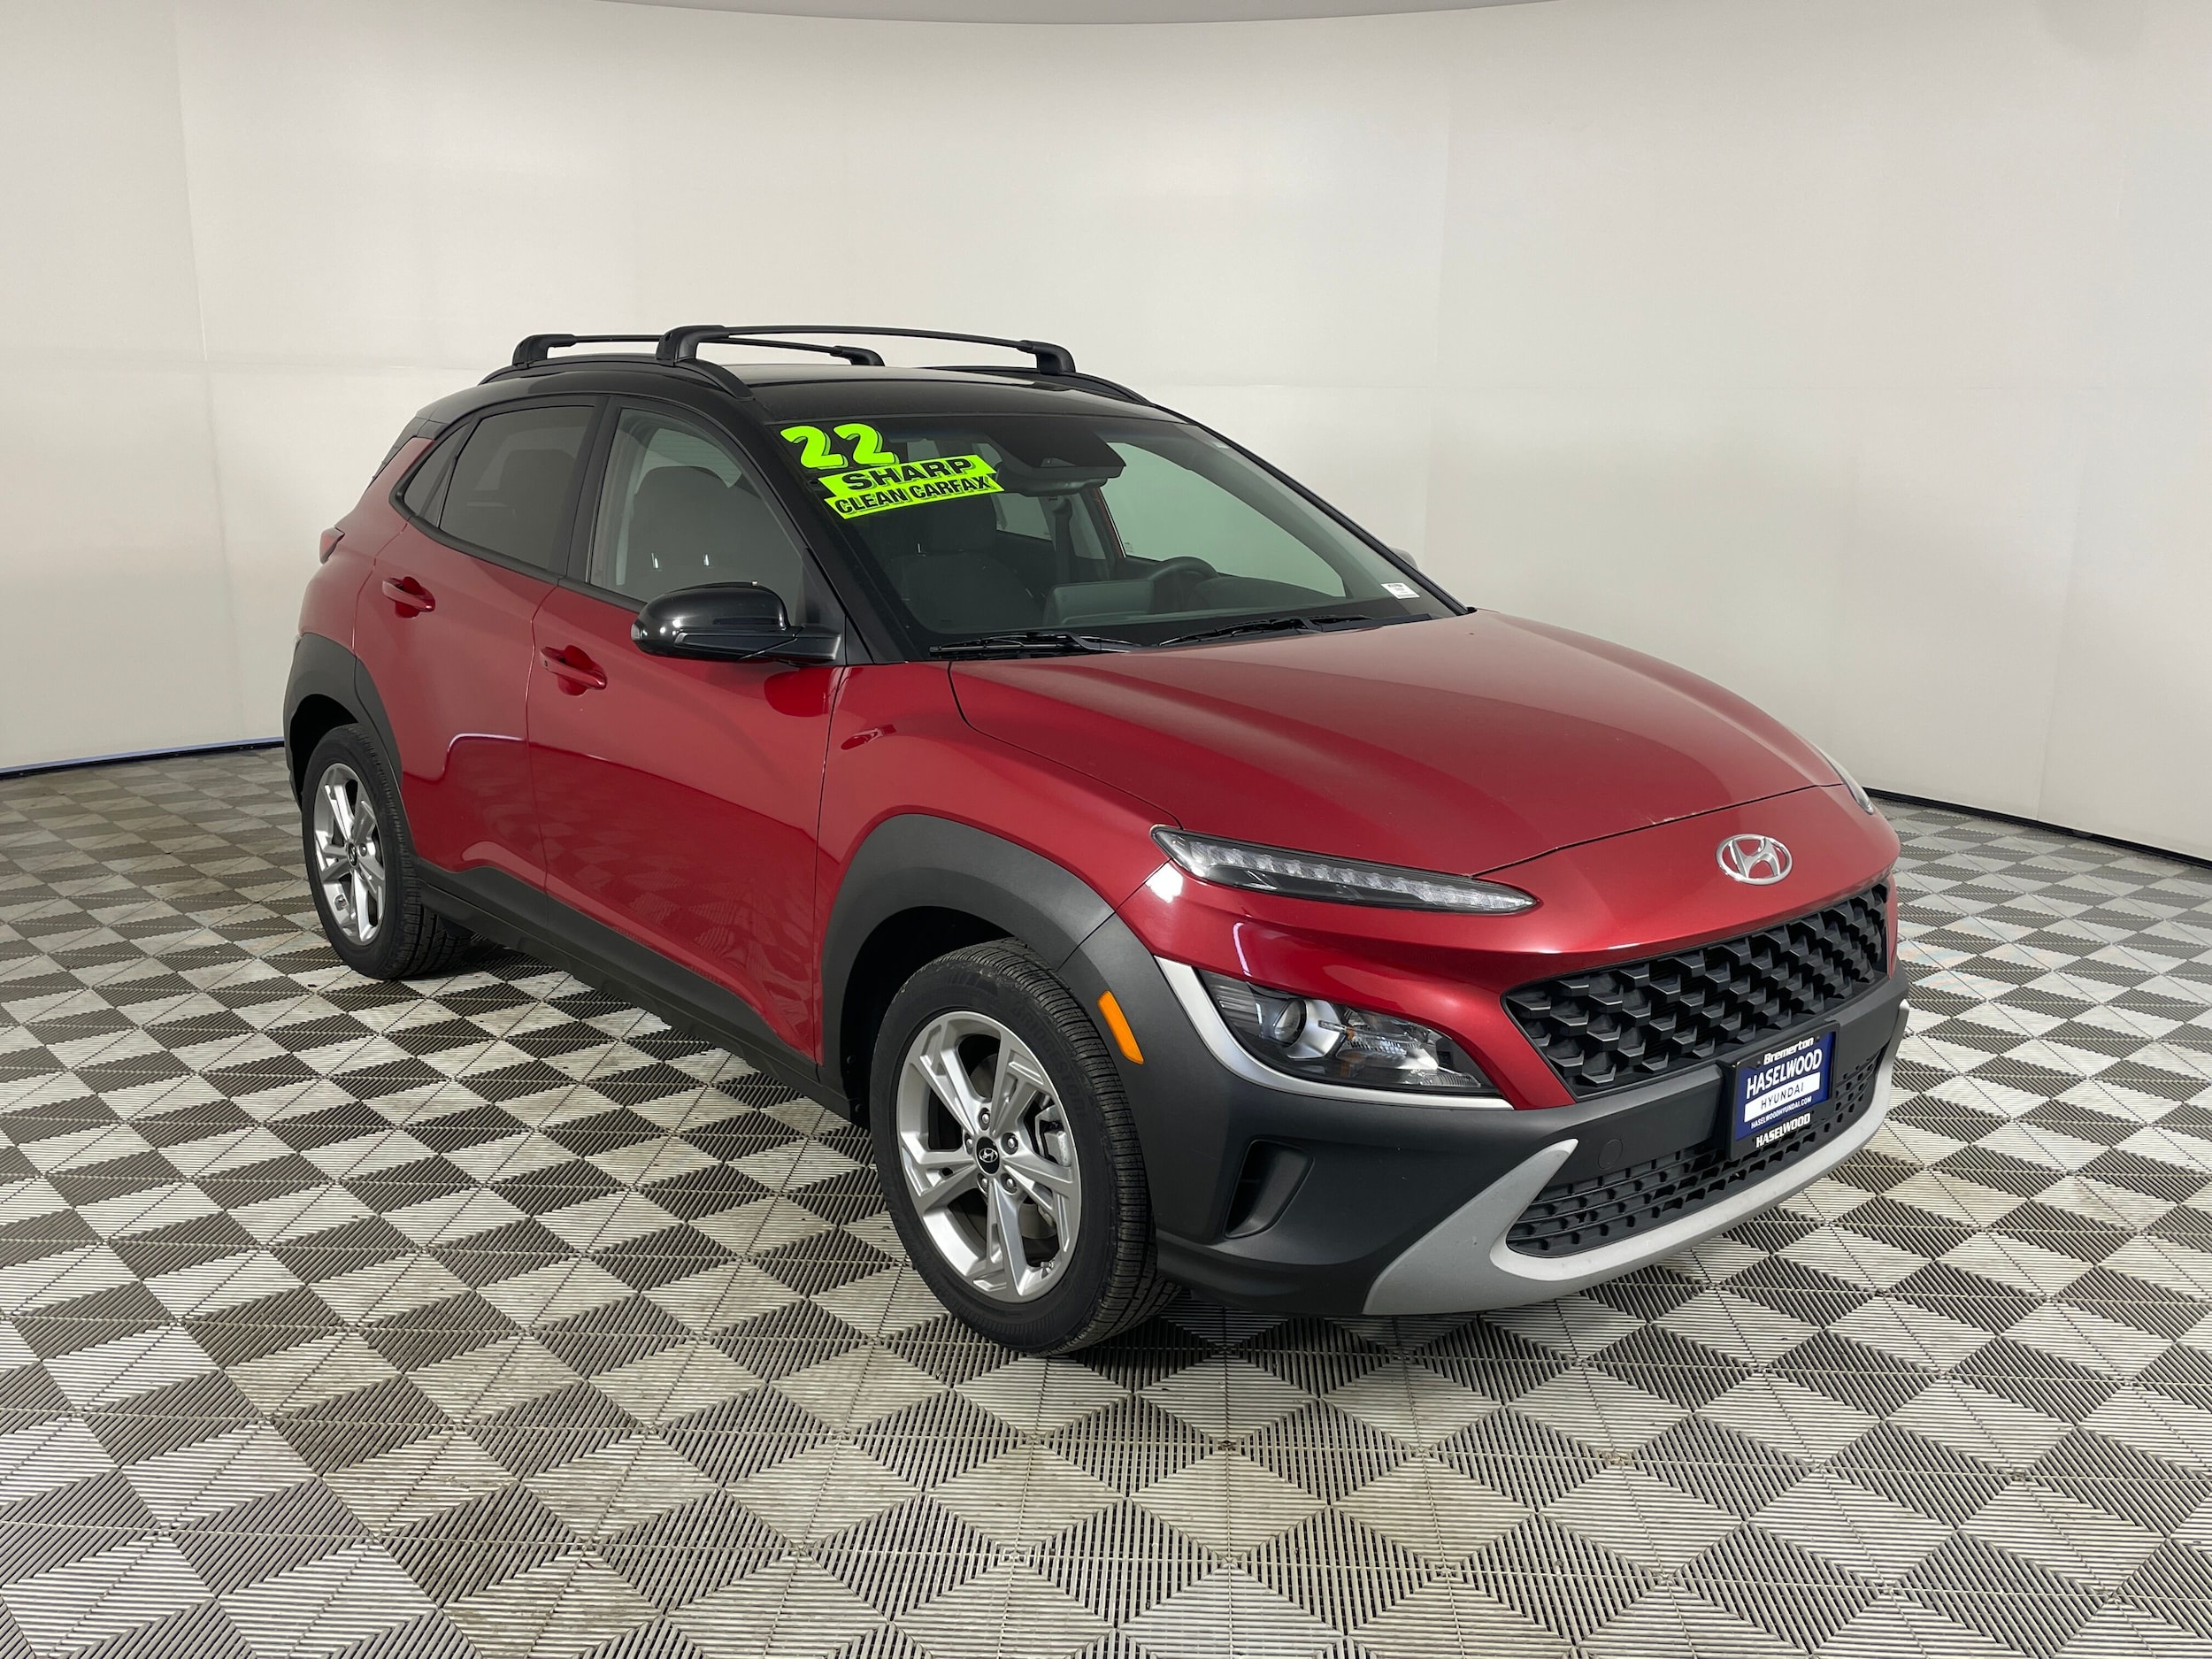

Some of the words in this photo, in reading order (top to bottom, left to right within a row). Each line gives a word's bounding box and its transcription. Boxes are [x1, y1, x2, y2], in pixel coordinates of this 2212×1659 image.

[780, 423, 899, 469] 22
[841, 457, 975, 491] SHARP
[834, 488, 909, 514] CLEAN
[910, 475, 991, 500] CARFAX
[1763, 1037, 1815, 1065] Bremerton
[1746, 1048, 1823, 1099] HASELWOOD
[1750, 1096, 1812, 1129] HASELWOODHYUNDAI.COM
[1761, 1082, 1804, 1110] HYUNDAI
[1755, 1112, 1811, 1148] HASELWOOD
